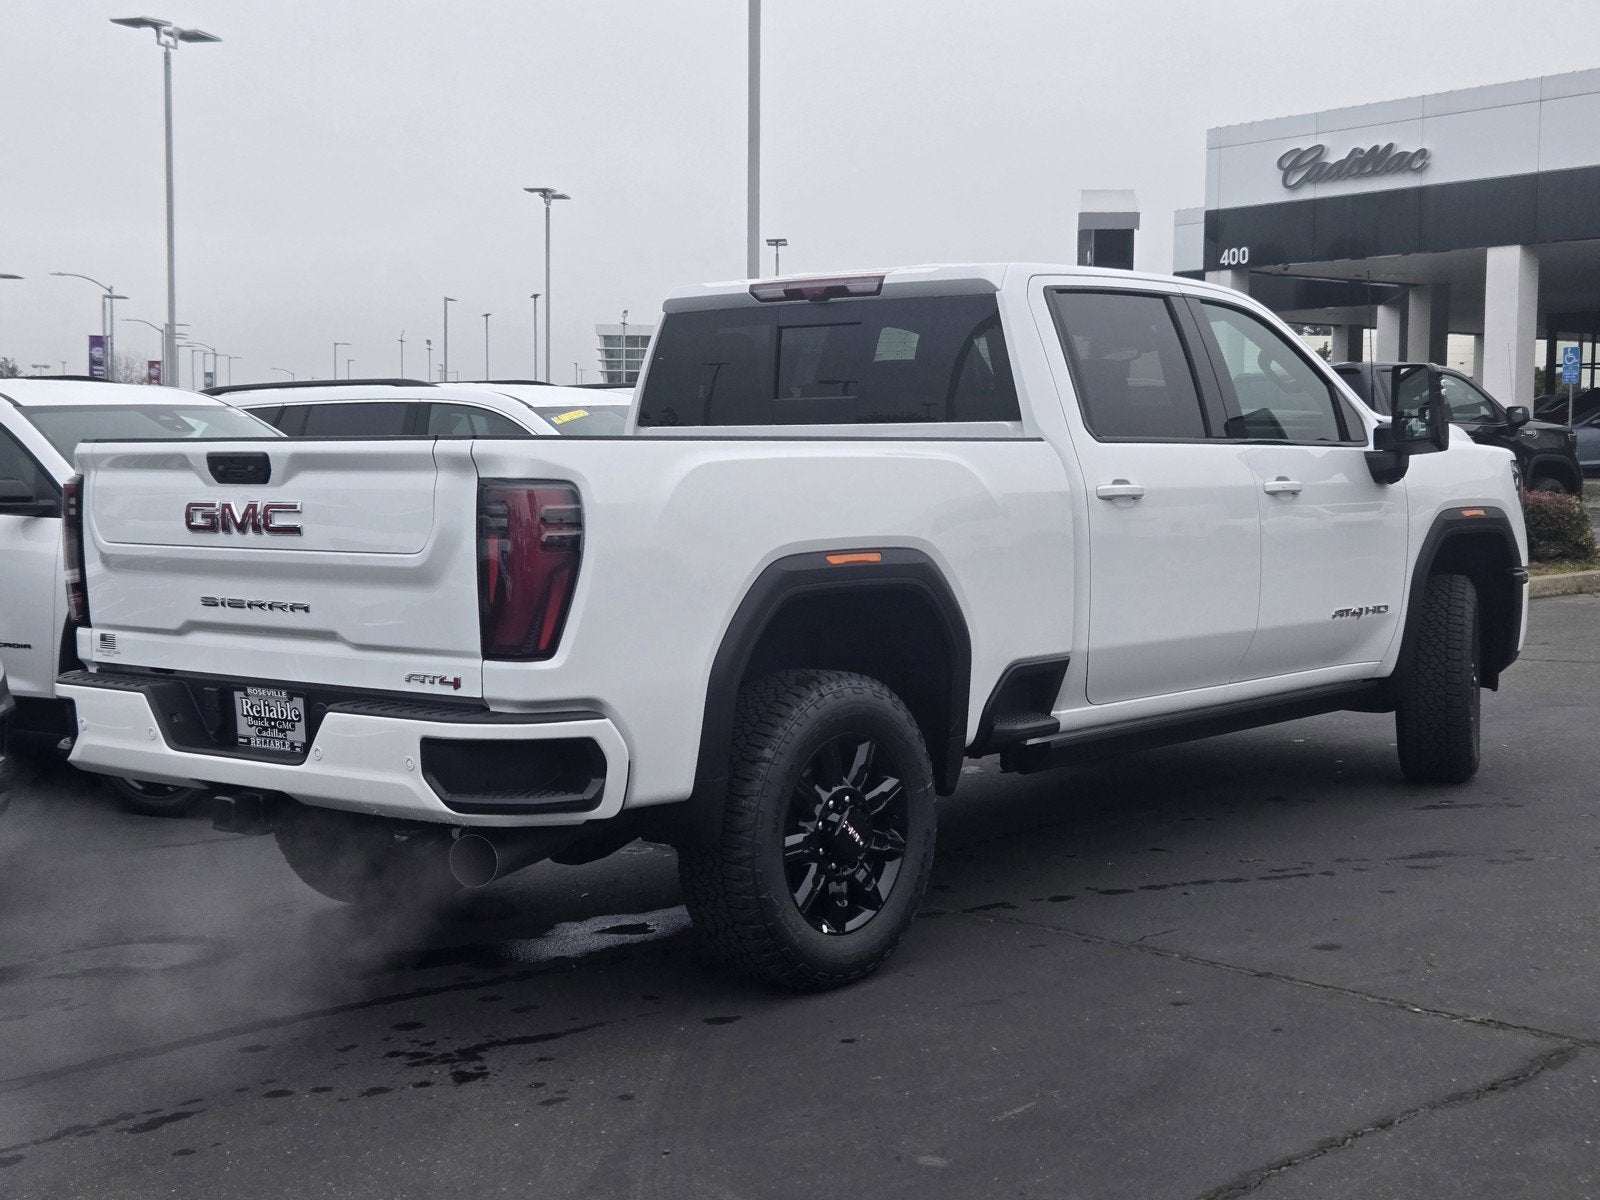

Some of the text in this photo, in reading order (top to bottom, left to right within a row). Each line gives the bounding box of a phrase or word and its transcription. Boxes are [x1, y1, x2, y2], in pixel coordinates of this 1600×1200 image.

[1276, 142, 1431, 190] Cadillac
[1219, 246, 1249, 266] 400
[184, 499, 303, 537] GMC
[200, 595, 311, 614] SIERRA
[404, 672, 462, 691] AT4
[247, 688, 288, 698] ROSEVILLE
[241, 698, 300, 721] Reliable
[247, 716, 295, 730] Buick GMC
[255, 726, 287, 739] Cadillac
[250, 737, 291, 751] RELIABLE
